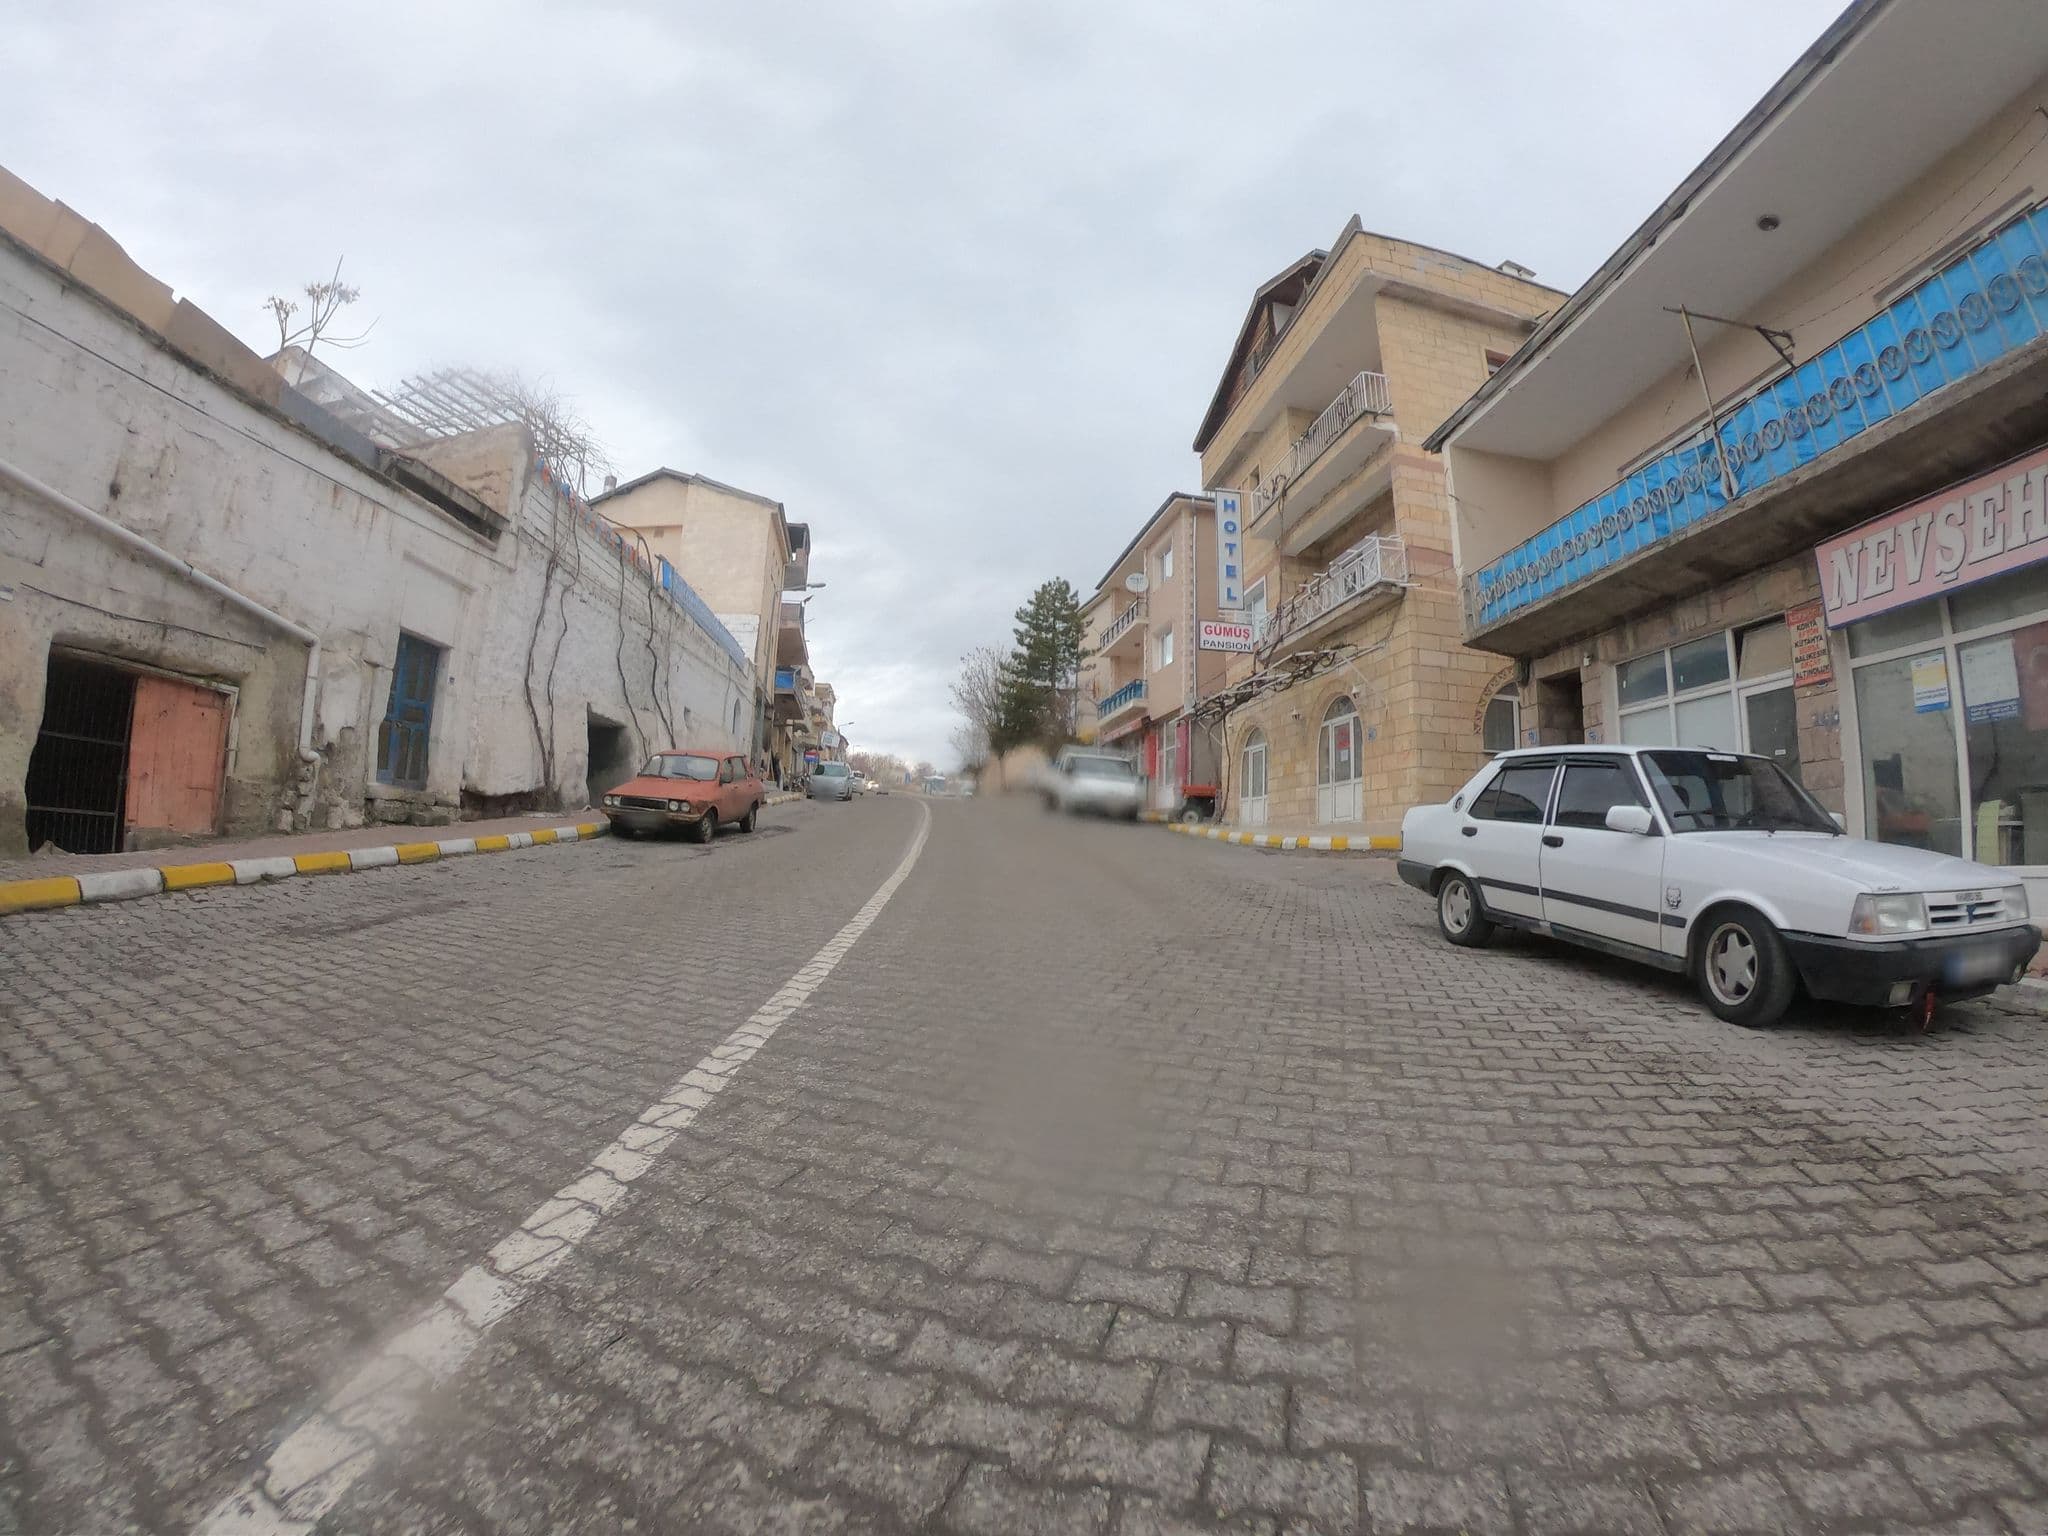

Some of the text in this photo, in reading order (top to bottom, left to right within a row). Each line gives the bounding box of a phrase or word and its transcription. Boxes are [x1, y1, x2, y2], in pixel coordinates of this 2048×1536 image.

[1223, 498, 1237, 601] HOTEL
[1204, 623, 1250, 641] GÜMÜŞ
[1203, 639, 1251, 650] PANSION
